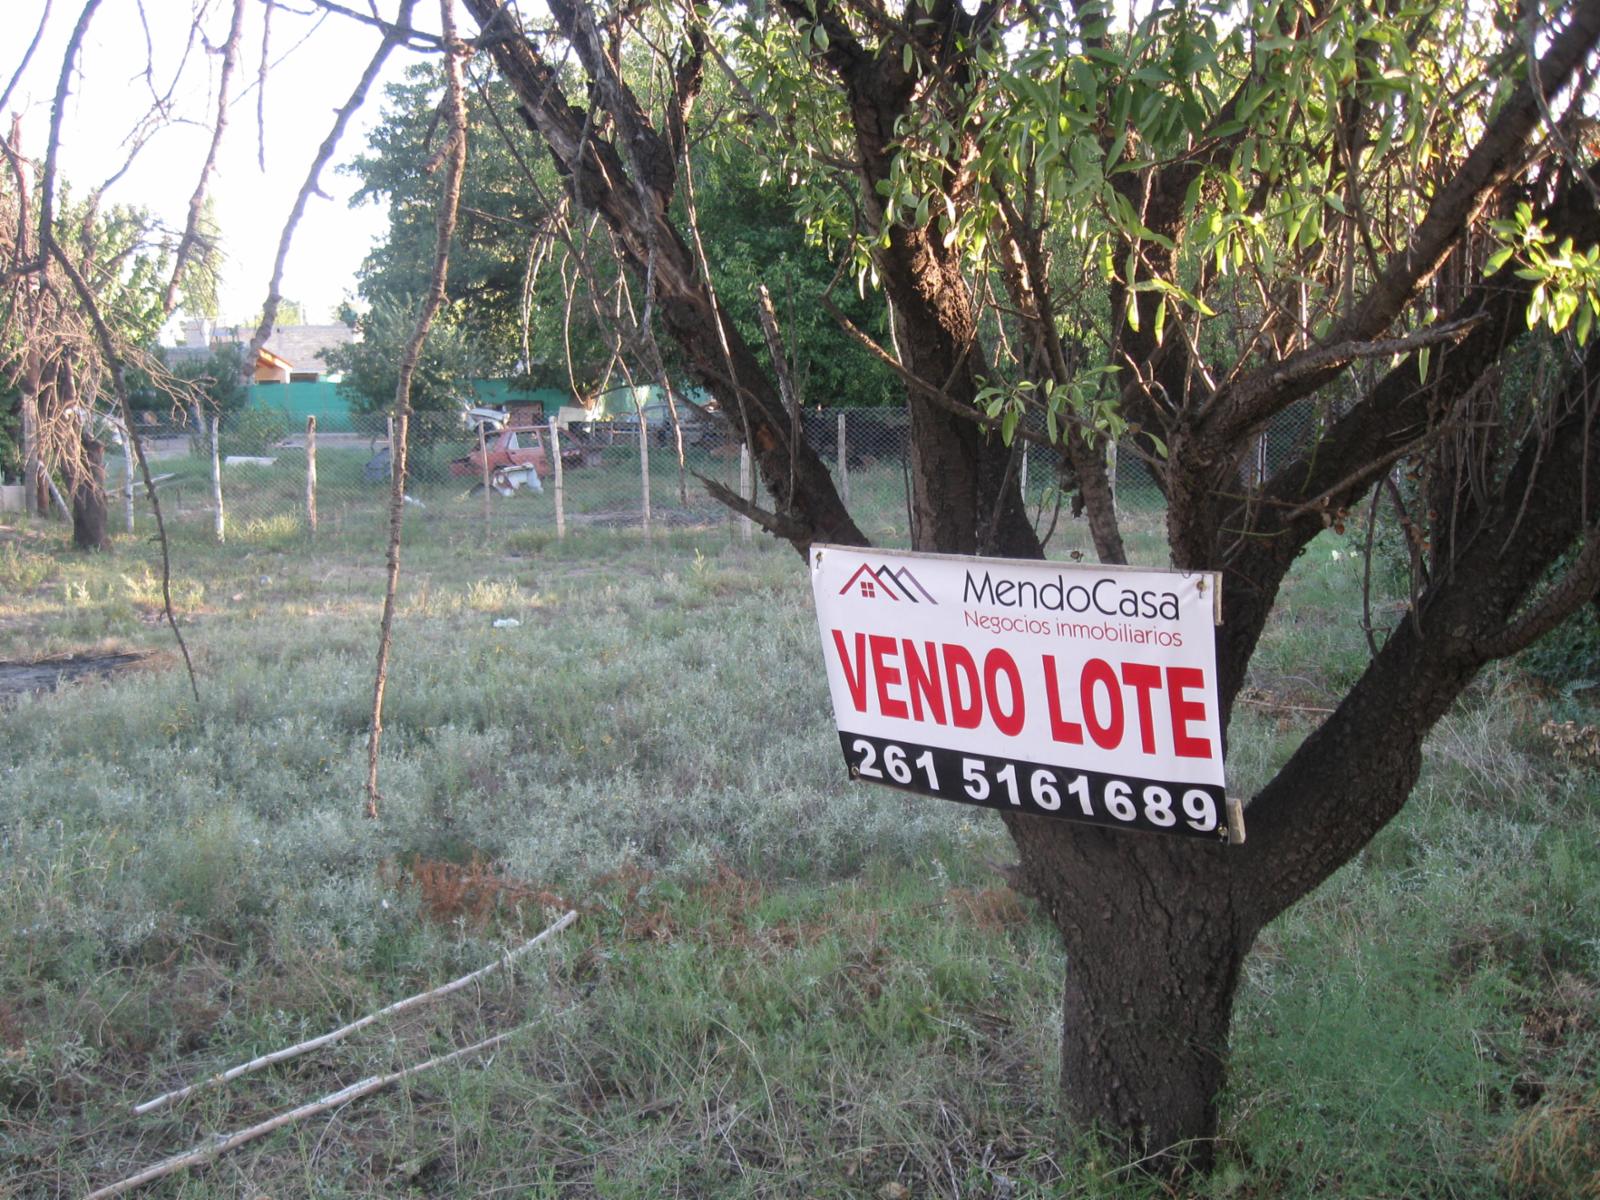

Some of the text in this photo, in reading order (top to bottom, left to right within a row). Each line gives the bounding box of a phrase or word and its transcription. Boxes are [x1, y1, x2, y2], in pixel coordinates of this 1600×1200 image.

[963, 569, 1180, 621] MendoCasa
[964, 610, 1183, 647] Negocios inmobiliarios
[831, 629, 1213, 759] VENDO LOTE
[852, 739, 1218, 832] 261 5161689
